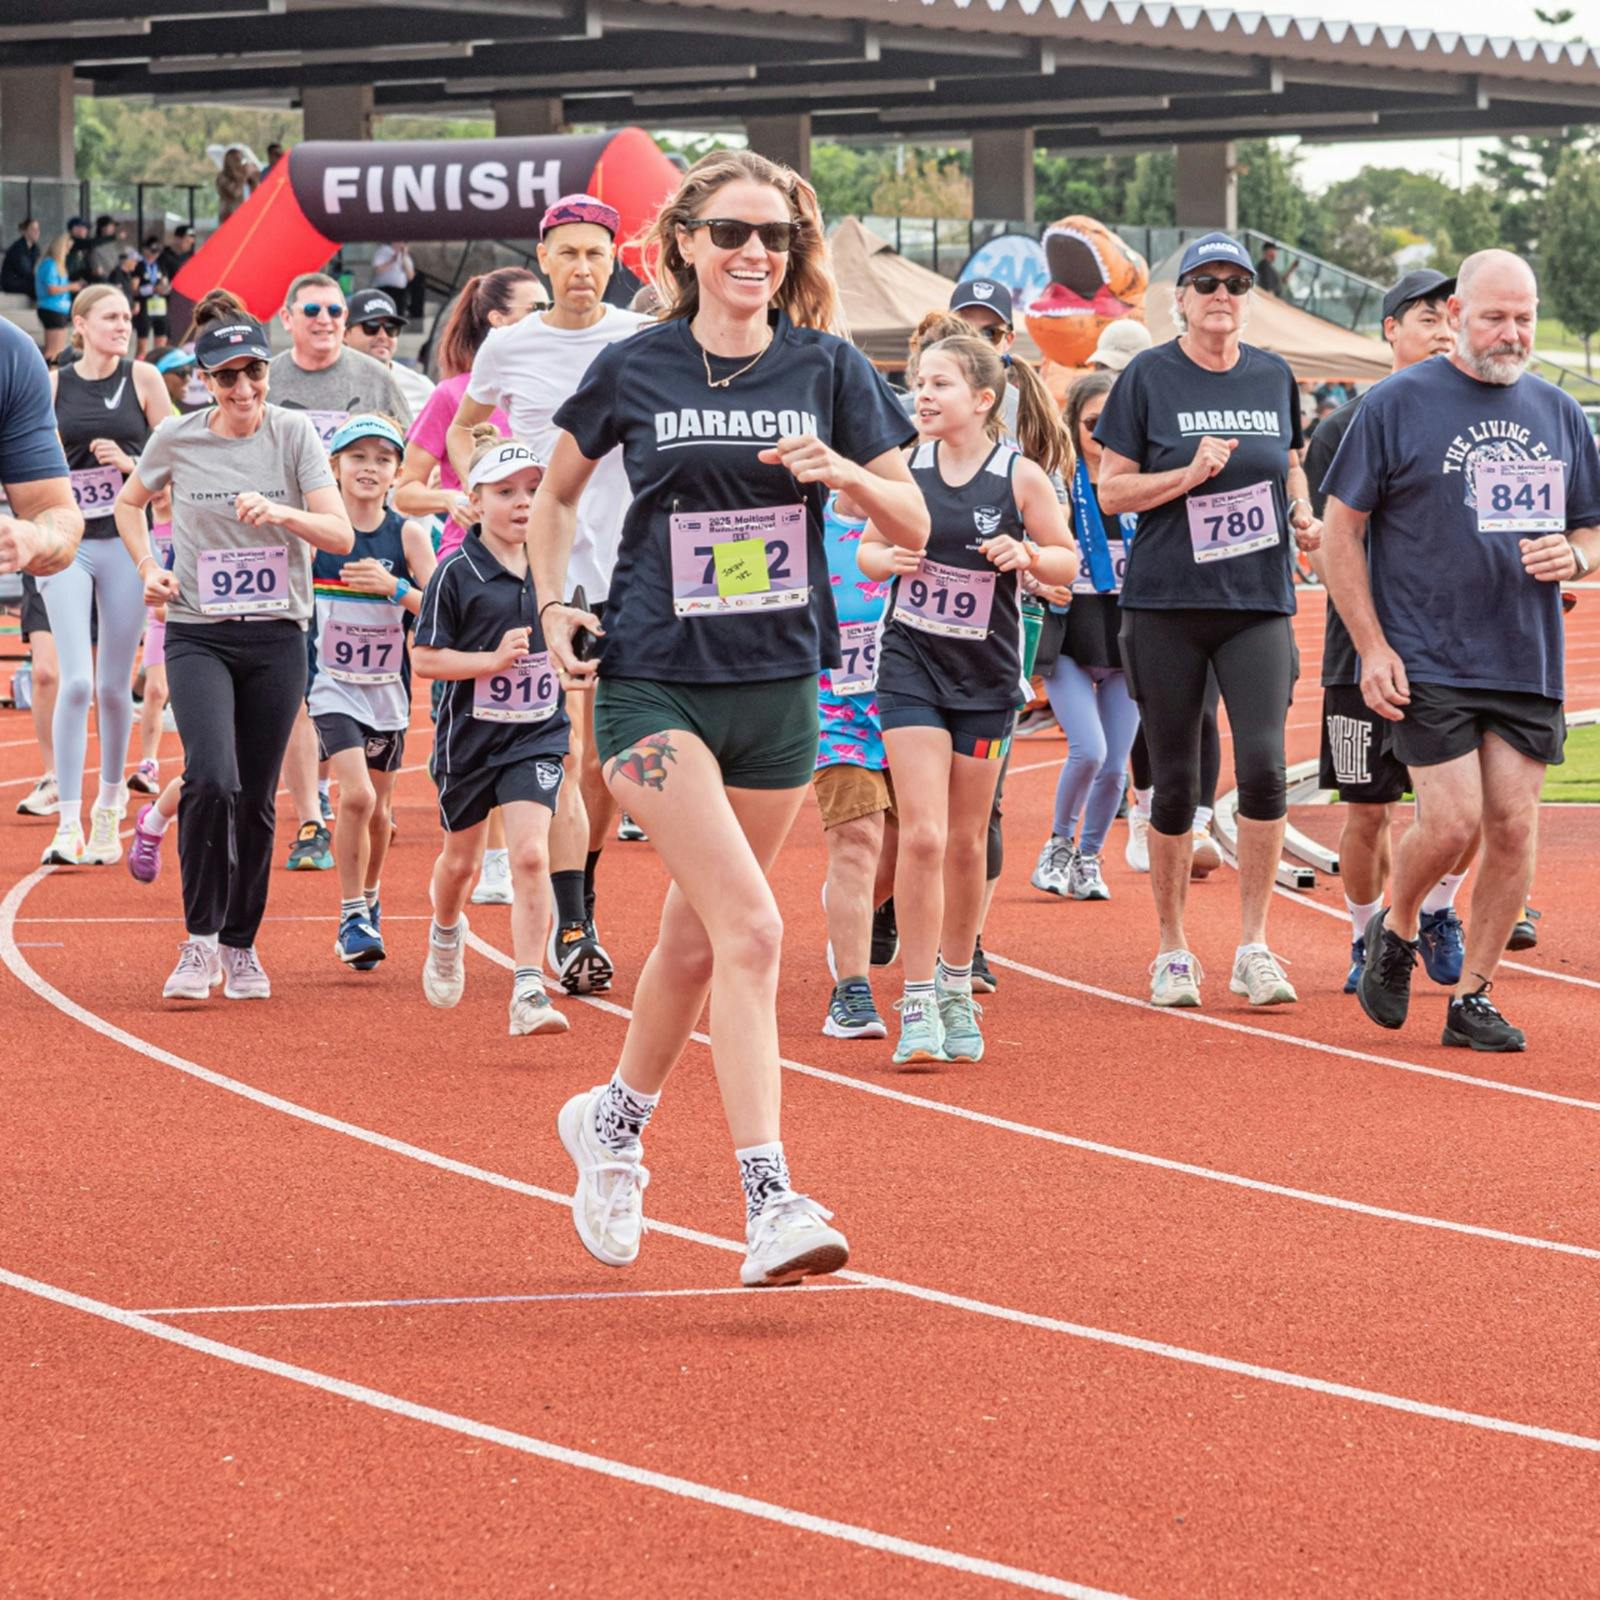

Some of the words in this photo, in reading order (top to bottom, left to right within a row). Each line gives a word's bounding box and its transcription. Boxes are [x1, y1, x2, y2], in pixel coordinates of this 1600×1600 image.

[323, 159, 562, 214] FINISH
[655, 408, 818, 444] DARACON
[1177, 410, 1279, 434] DARACON
[1443, 435, 1472, 474] THE
[1468, 420, 1531, 446] LIVING
[191, 491, 229, 501] TOMMY
[1491, 483, 1551, 512] 841
[734, 513, 776, 524] Maitland
[1203, 506, 1264, 541] 780
[694, 540, 791, 585] 72
[212, 568, 277, 596] 920
[908, 580, 977, 619] 919
[335, 641, 393, 668] 917
[841, 645, 877, 675] 79
[490, 672, 552, 704] 916
